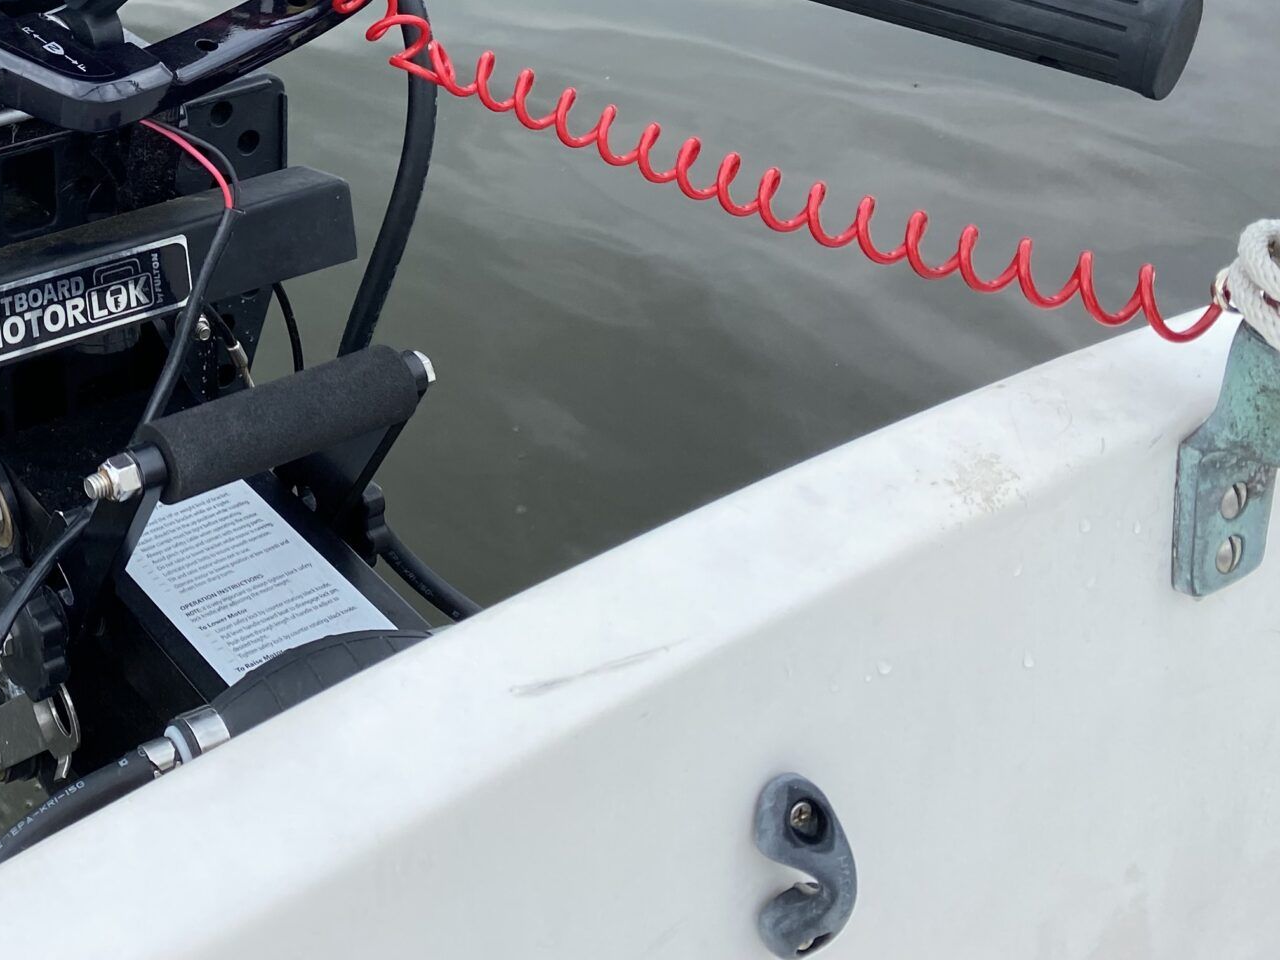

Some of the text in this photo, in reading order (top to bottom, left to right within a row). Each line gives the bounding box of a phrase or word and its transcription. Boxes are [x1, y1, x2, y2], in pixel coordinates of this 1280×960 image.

[21, 26, 34, 35] R
[76, 63, 87, 72] F
[151, 253, 162, 293] FULTON
[178, 572, 265, 611] OPERATION INSTRUCTIONS
[206, 617, 228, 628] Lower
[226, 608, 248, 619] Motor
[244, 657, 263, 669] Raise
[262, 649, 283, 662] Motor
